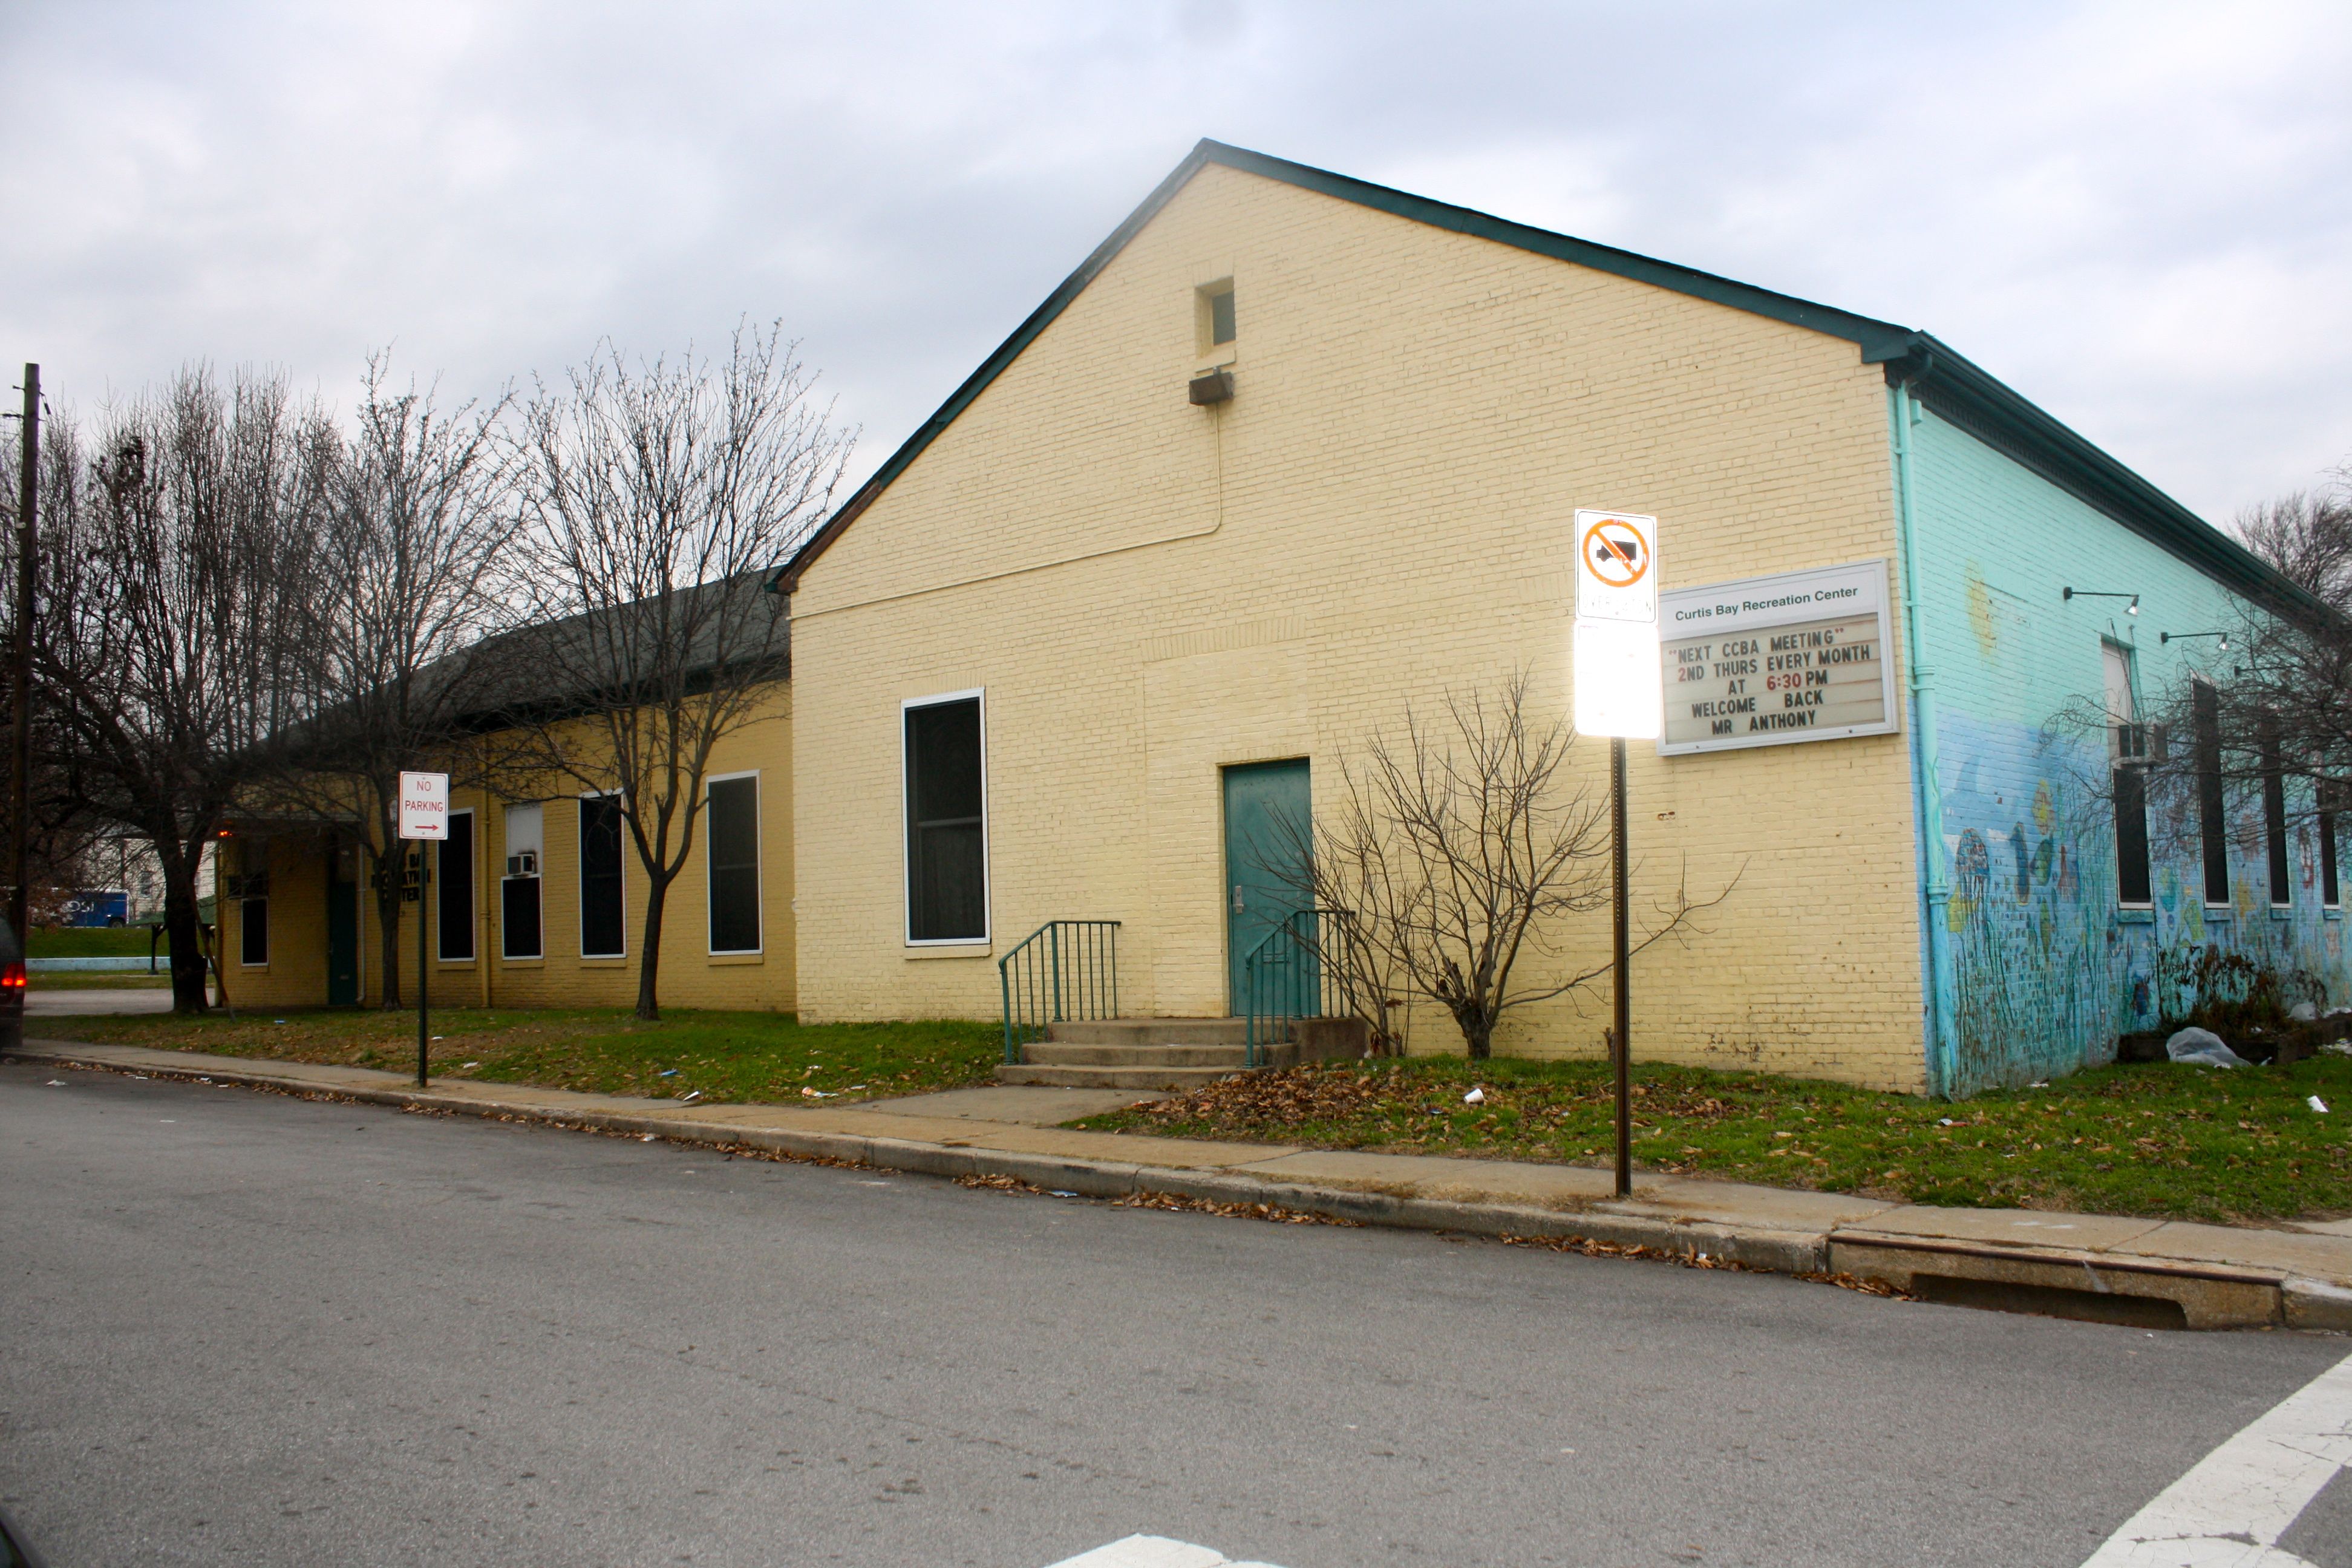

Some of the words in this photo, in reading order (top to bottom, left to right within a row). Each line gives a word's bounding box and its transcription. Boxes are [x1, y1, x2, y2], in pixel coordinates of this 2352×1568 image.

[1676, 607, 1712, 621] Curtis
[1716, 605, 1739, 615] Bay
[1743, 594, 1811, 612] Recreation
[1815, 587, 1858, 601] Center
[1722, 639, 1759, 658] CCBA
[1678, 665, 1704, 682] 2ND
[1713, 658, 1758, 678] THURS
[1766, 652, 1811, 671] EVERY
[1818, 644, 1870, 665] MONTH
[1728, 679, 1745, 696] AT
[1766, 672, 1802, 691] 6:30
[1806, 669, 1828, 687] PM
[1691, 697, 1756, 718] WELCOME
[1784, 689, 1823, 708] BACK
[1711, 719, 1733, 736] MR
[1749, 709, 1815, 731] ANTHONY
[417, 780, 431, 792] NO
[405, 800, 443, 812] PARKING
